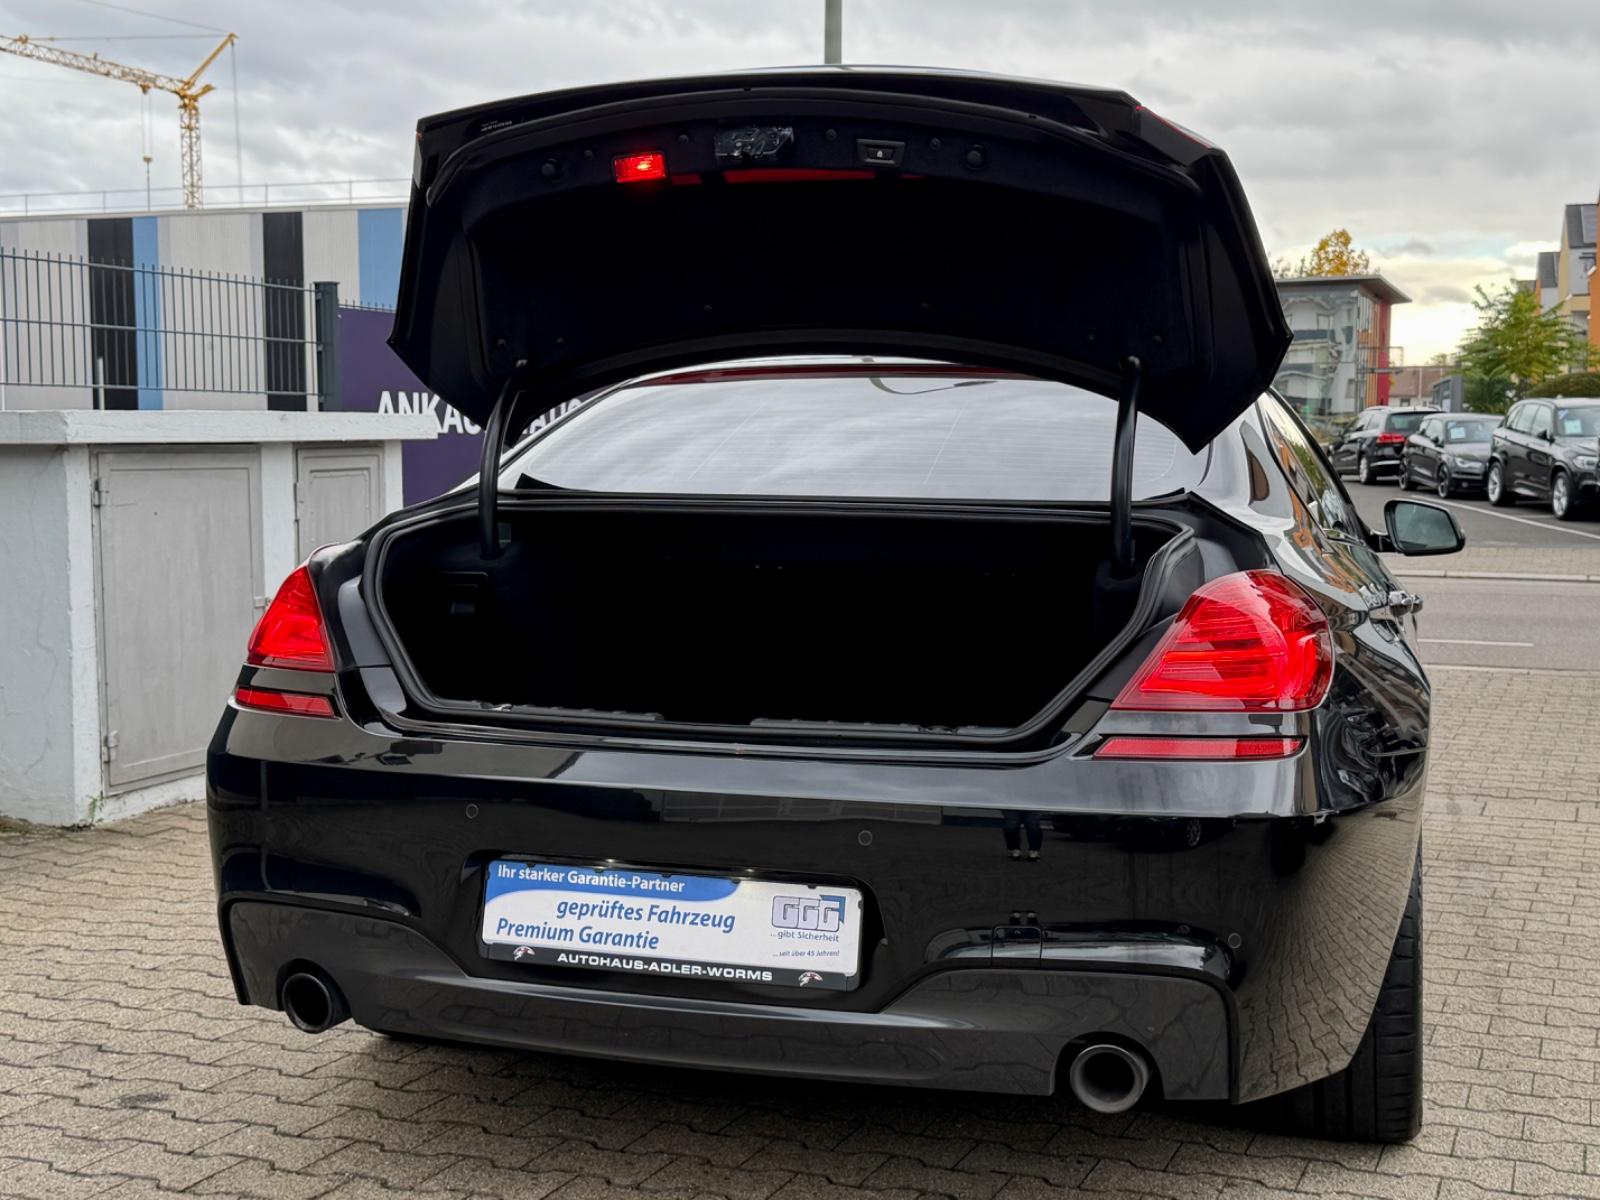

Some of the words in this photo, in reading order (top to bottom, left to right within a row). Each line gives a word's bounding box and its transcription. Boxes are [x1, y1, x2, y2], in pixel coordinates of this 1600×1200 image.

[498, 864, 516, 879] Ihr
[519, 867, 565, 882] starker
[568, 871, 685, 892] Garantie-Partner
[557, 900, 643, 921] geprüftes
[647, 905, 736, 933] Fahrzeug
[496, 918, 575, 942] Premium
[579, 926, 660, 950] Garantie
[797, 931, 840, 943] Sicherheit
[557, 952, 773, 982] AUTOHAUS-ADLER-WORMS
